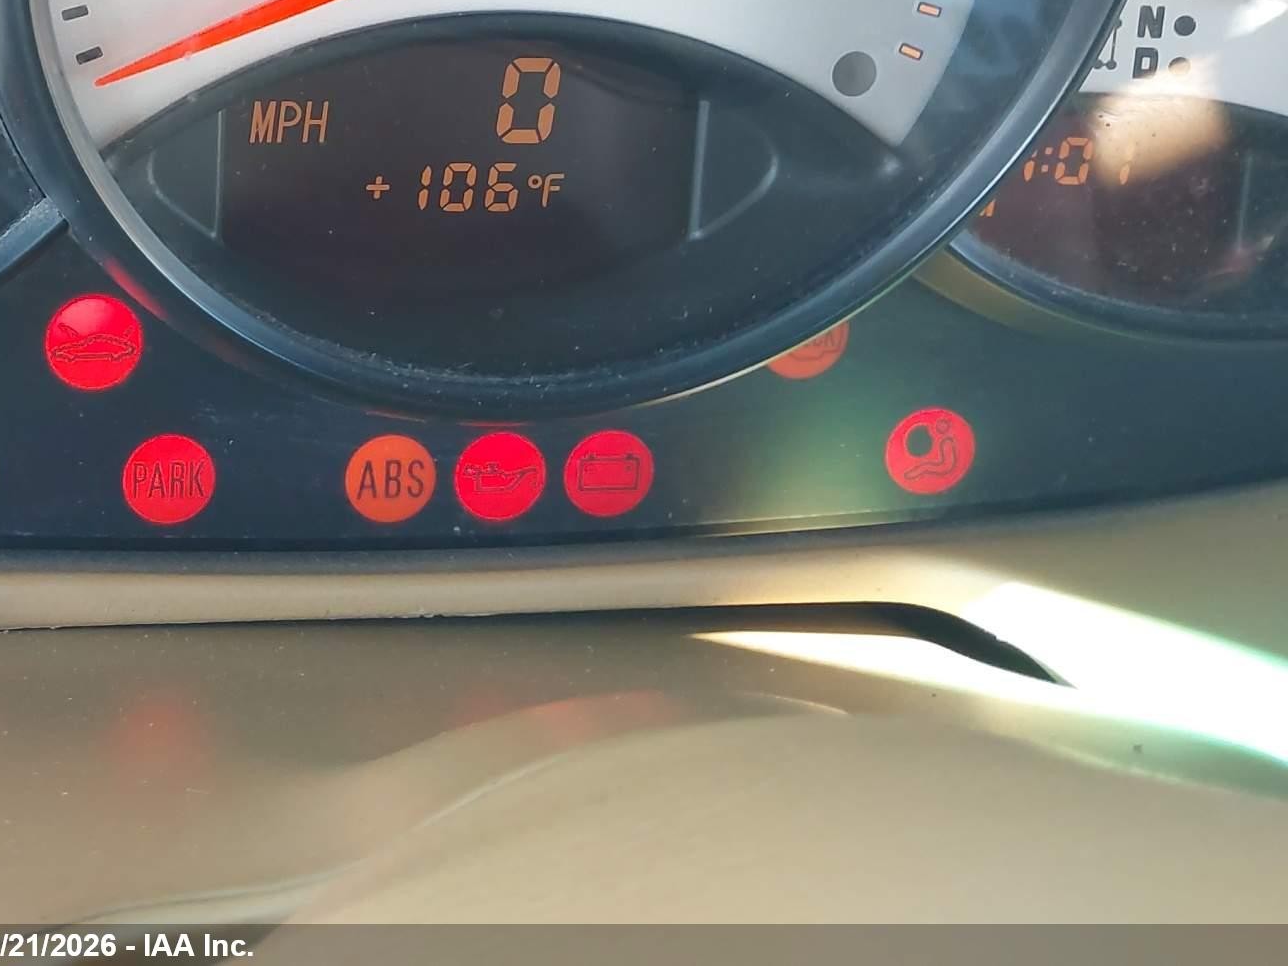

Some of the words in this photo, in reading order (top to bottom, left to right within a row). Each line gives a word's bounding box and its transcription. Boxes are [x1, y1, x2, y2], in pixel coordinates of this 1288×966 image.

[1137, 6, 1165, 38] N
[1132, 47, 1158, 79] D
[496, 57, 561, 144] 0
[249, 100, 329, 144] MPH
[132, 459, 205, 500] PARK
[356, 459, 425, 500] ABS
